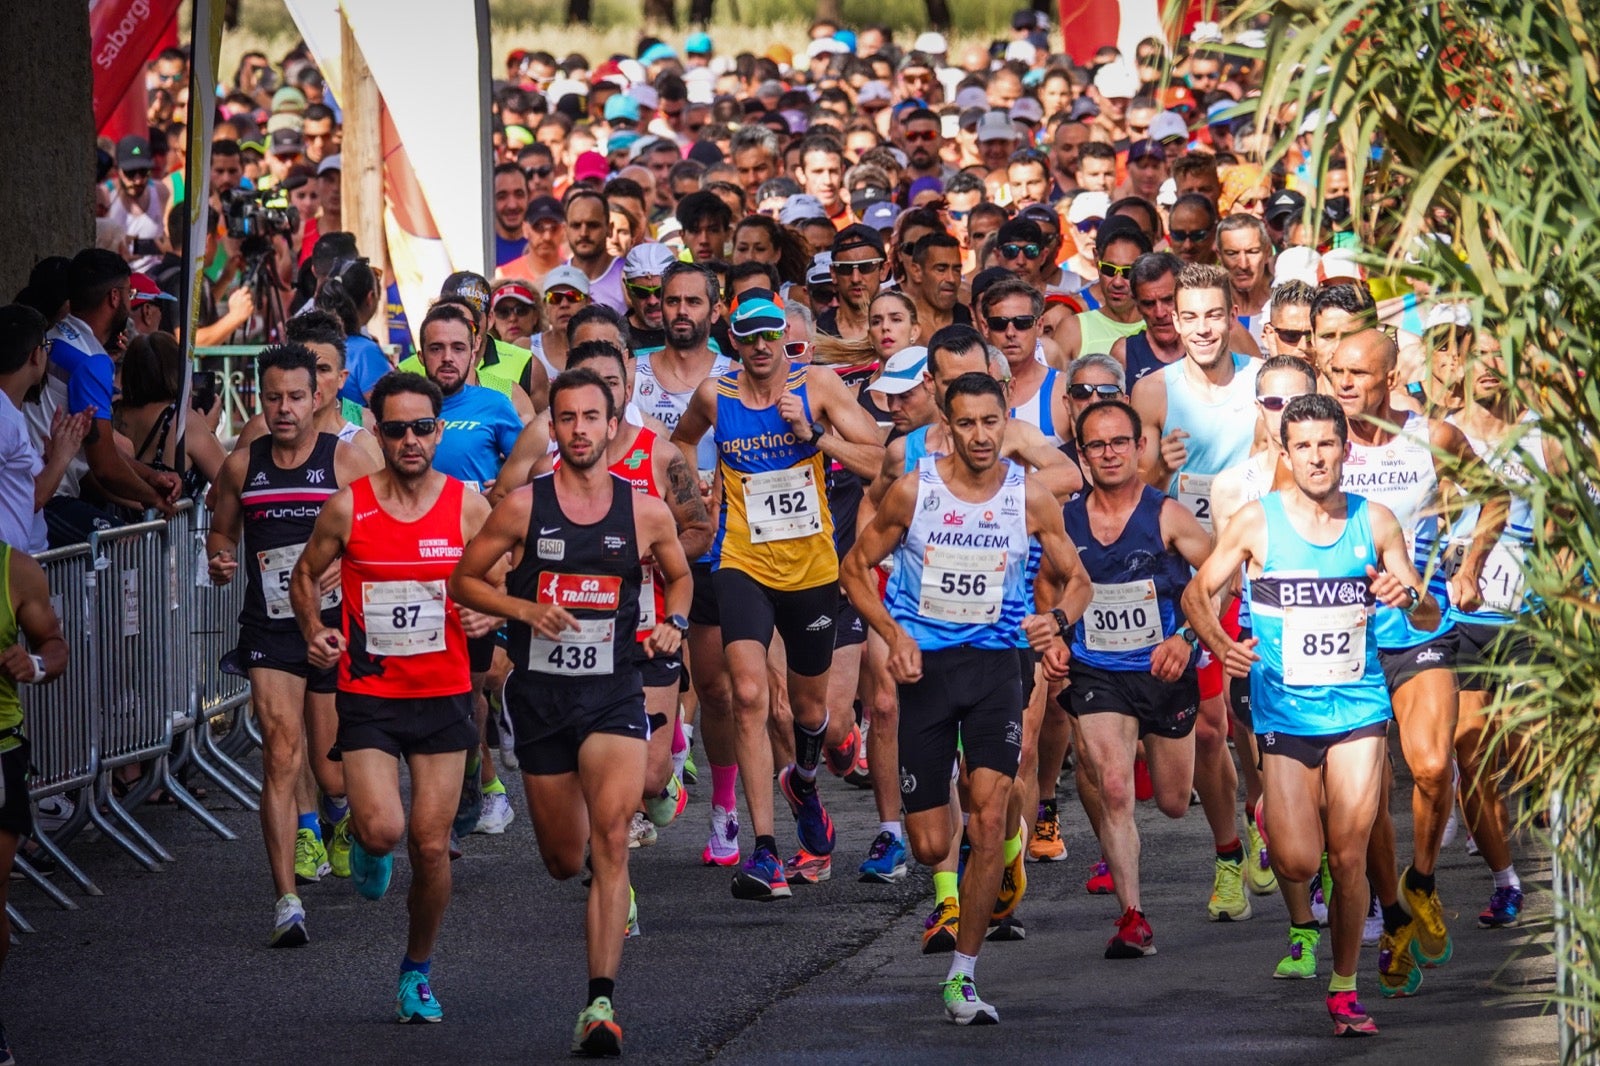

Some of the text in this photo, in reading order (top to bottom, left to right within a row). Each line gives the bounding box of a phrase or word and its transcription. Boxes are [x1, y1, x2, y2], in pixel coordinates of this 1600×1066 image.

[764, 490, 808, 516] 152
[418, 538, 449, 547] RUNNING
[927, 531, 1010, 548] MARACENA
[419, 547, 464, 558] VAMPIROS
[940, 572, 987, 596] 556
[561, 590, 616, 604] TRAINING
[392, 605, 421, 629] 87
[1093, 607, 1147, 631] 3010
[1302, 631, 1351, 656] 852
[547, 644, 597, 670] 438
